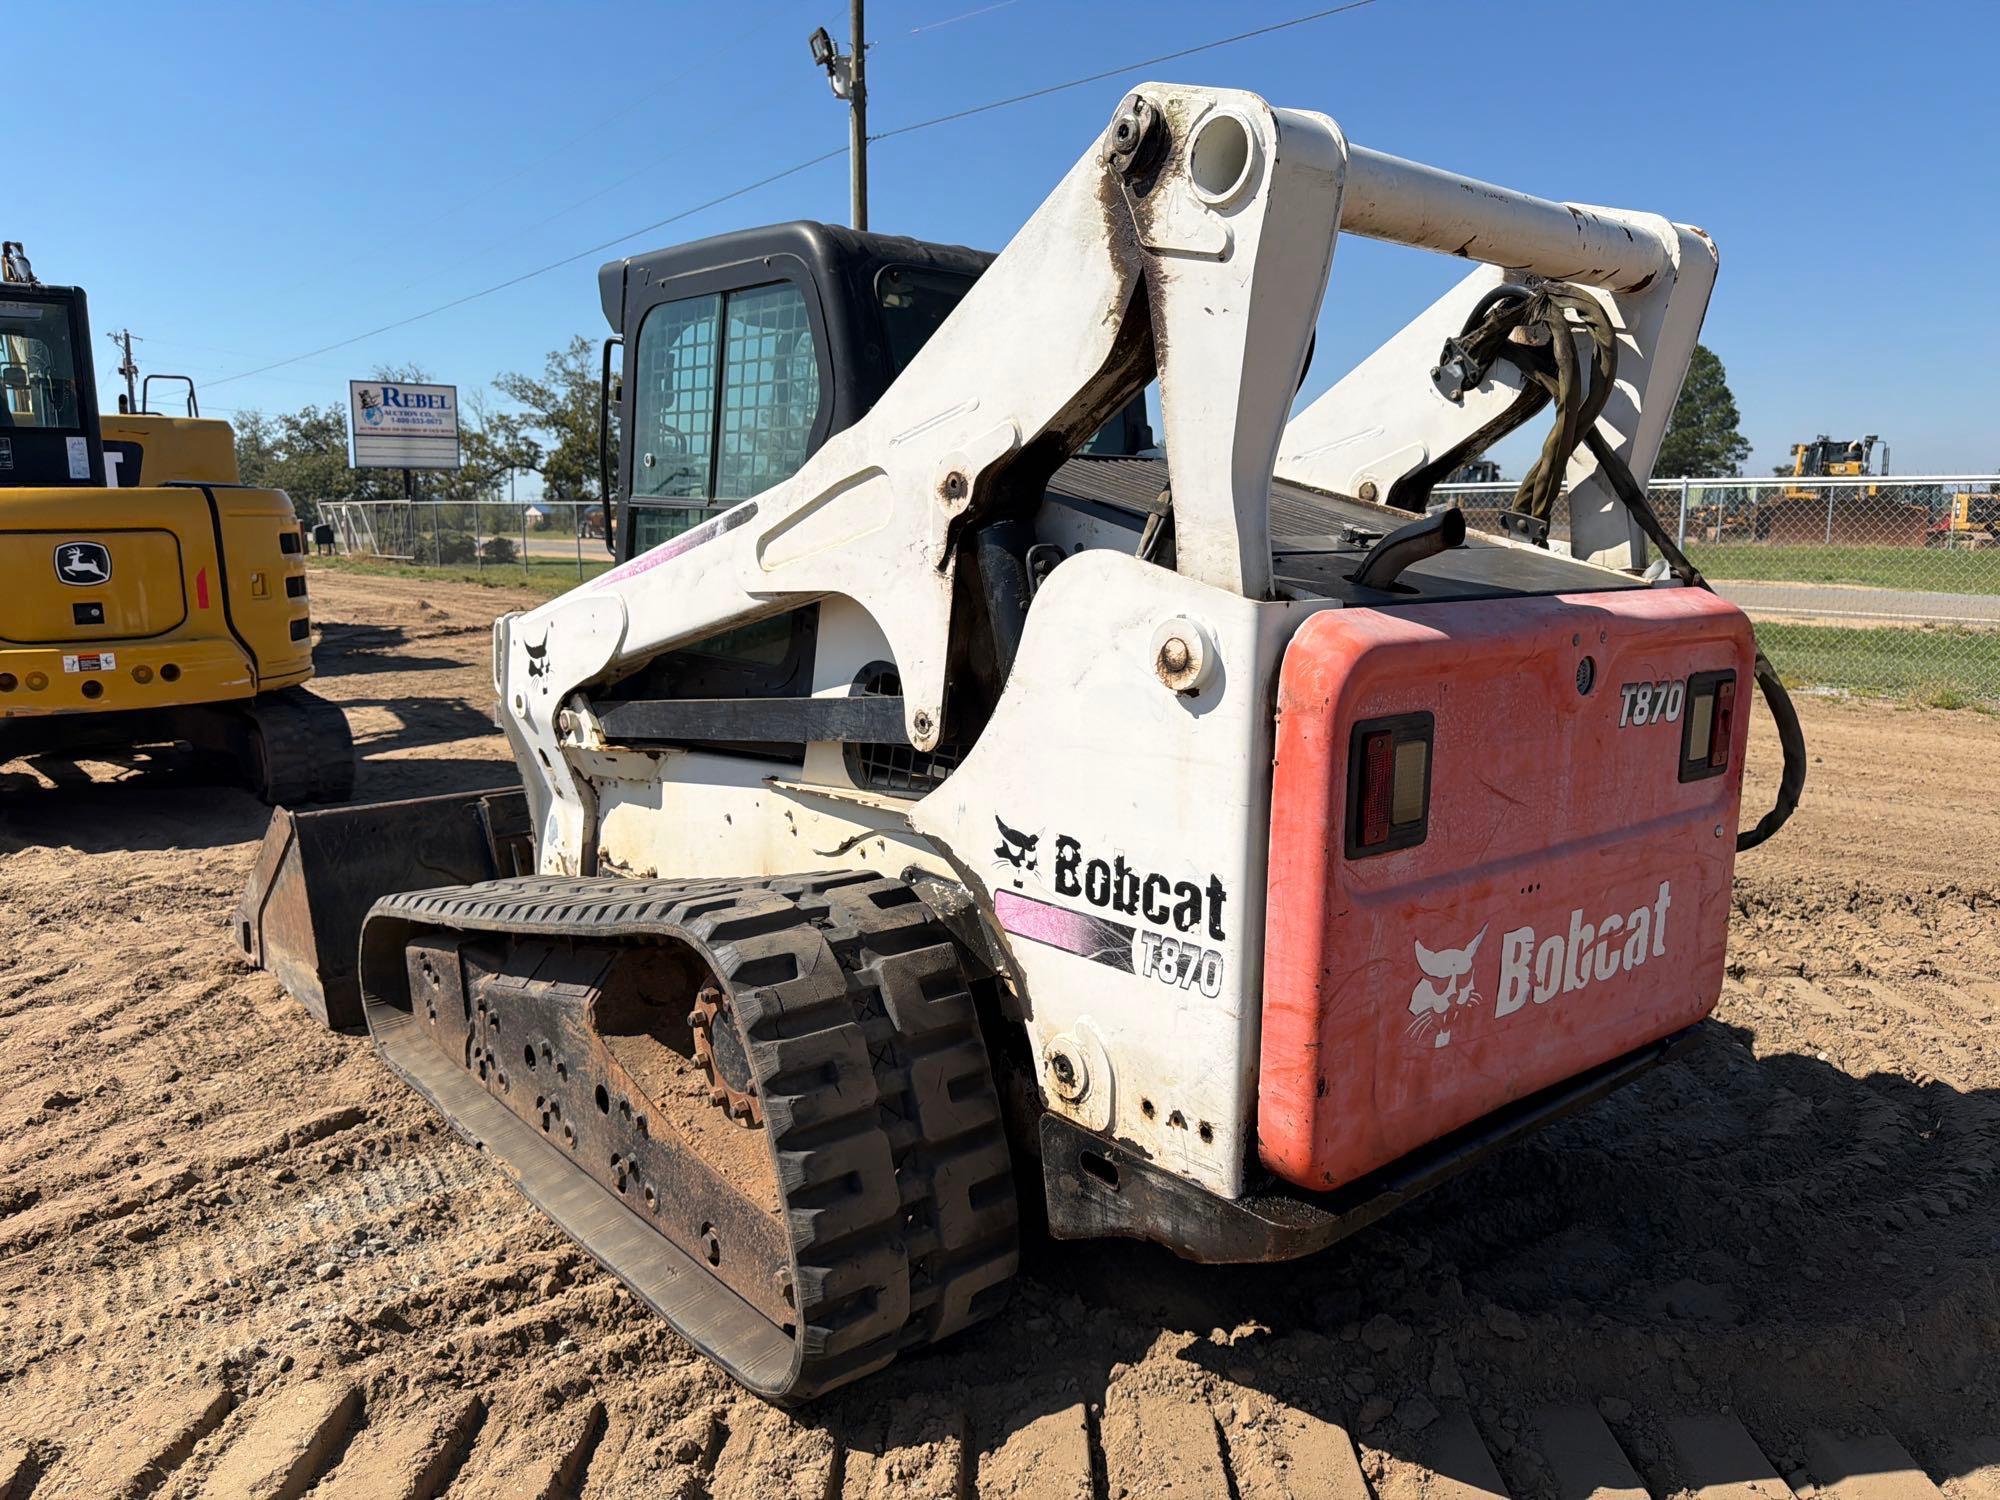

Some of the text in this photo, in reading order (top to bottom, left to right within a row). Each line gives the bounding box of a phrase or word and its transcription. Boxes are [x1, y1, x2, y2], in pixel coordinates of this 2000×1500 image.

[381, 387, 452, 409] REBEL
[1619, 680, 1684, 728] T870
[1055, 833, 1226, 941] Bobcat
[1141, 929, 1224, 999] T870
[1495, 880, 1671, 1019] Bobcat
